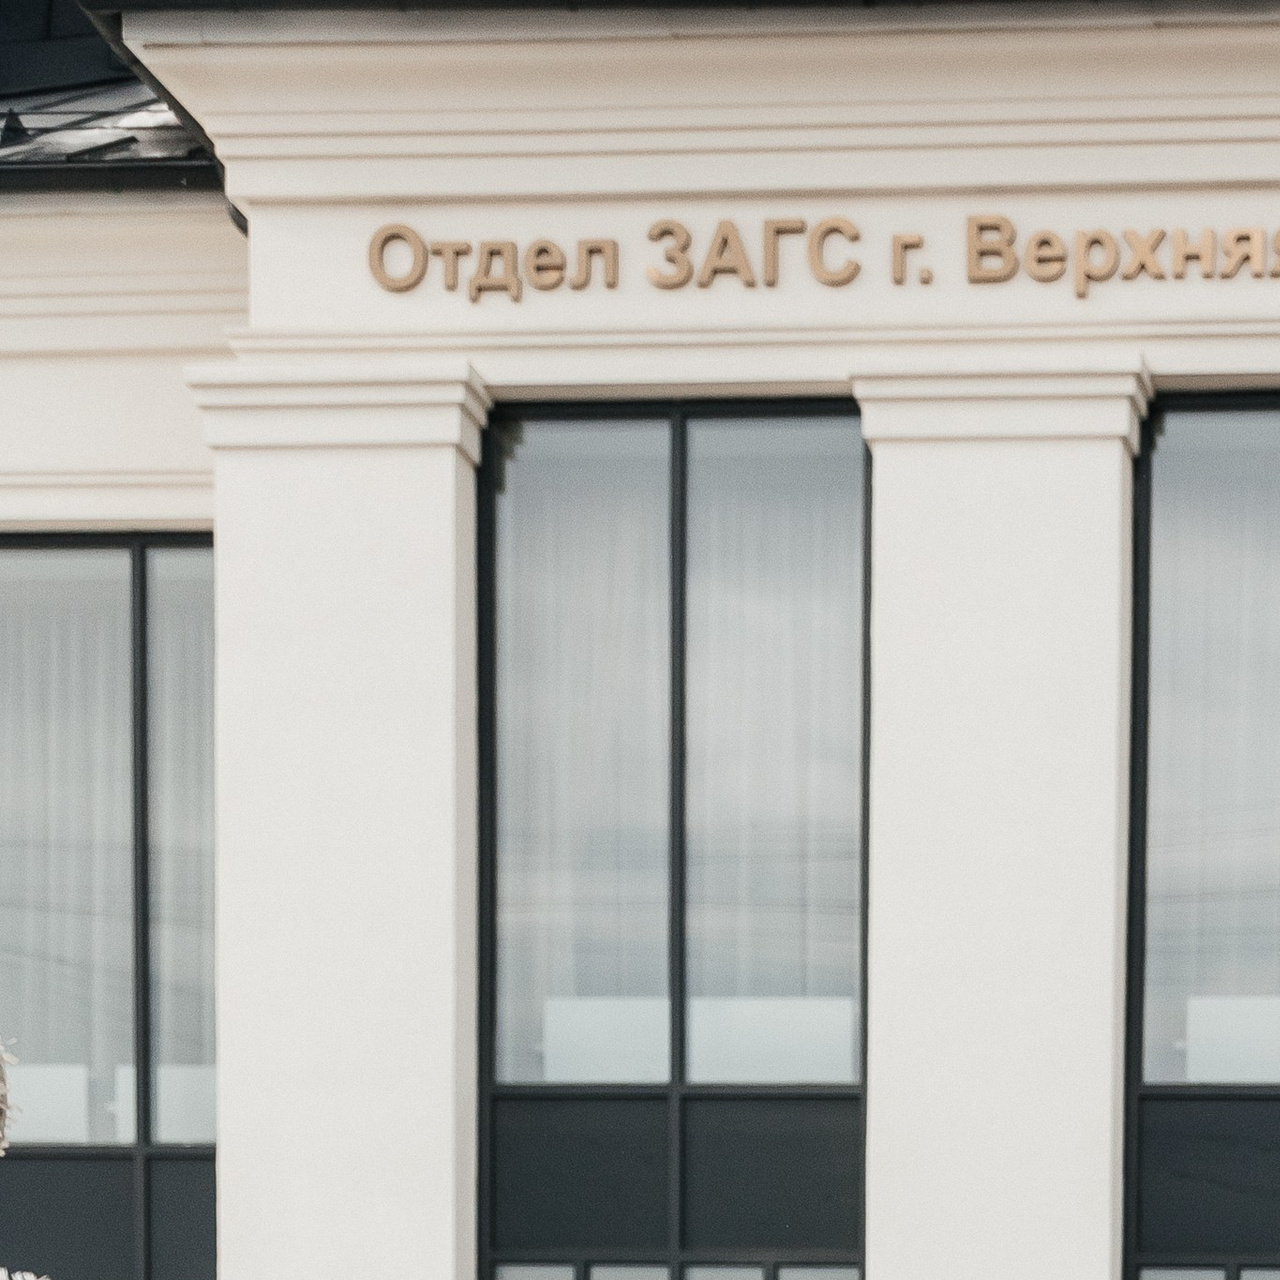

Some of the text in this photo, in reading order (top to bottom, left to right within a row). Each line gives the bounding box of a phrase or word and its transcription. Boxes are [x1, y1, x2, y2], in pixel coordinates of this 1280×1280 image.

[368, 223, 620, 303] Отдел
[647, 216, 862, 290] ЗАГС
[890, 233, 933, 286] г.
